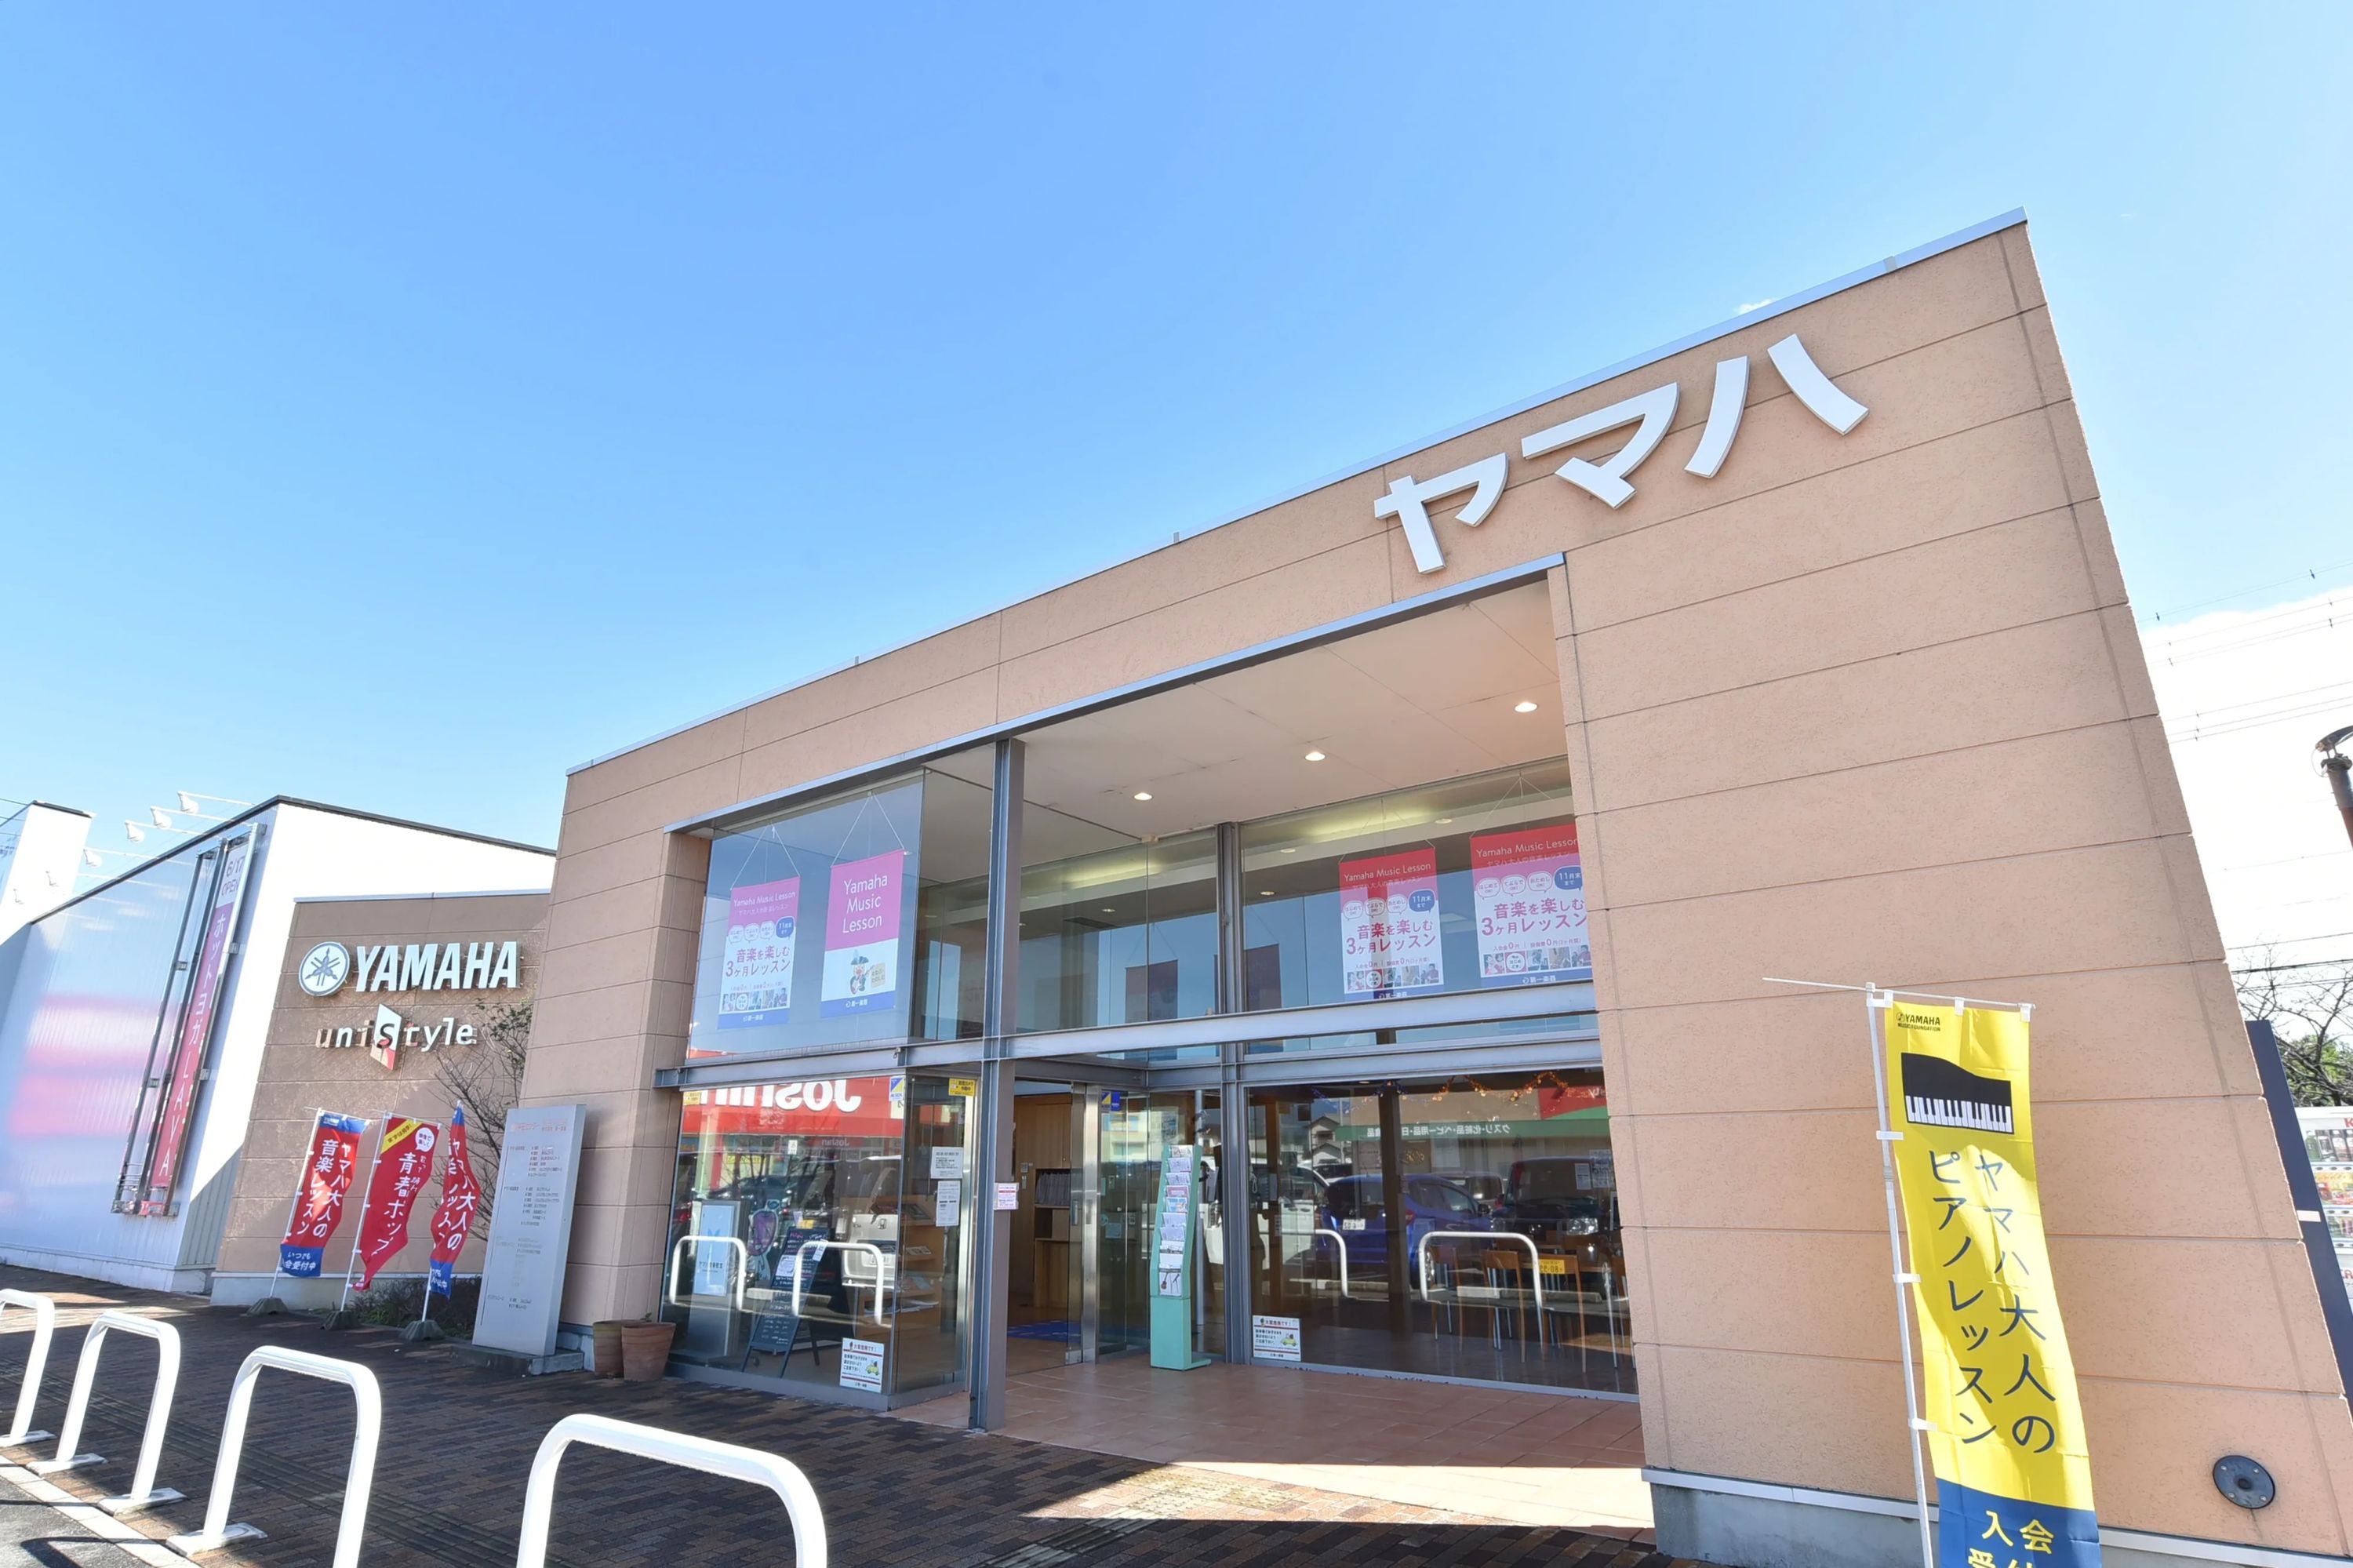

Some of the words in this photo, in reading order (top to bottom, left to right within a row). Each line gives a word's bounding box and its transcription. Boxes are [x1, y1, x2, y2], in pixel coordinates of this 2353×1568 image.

[1374, 334, 1870, 574] ヤマハ
[1476, 847, 1512, 858] Yamaha
[1344, 871, 1374, 882] Yamaha
[1377, 868, 1401, 877] Music
[1402, 863, 1431, 873] Lesson
[844, 874, 888, 895] Yamaha
[733, 896, 755, 907] Yamaha
[756, 895, 773, 905] Music
[775, 891, 795, 900] Lesson
[846, 894, 881, 914] Music
[1494, 898, 1584, 919] 音楽を楽しむ
[842, 915, 882, 933] Lesson
[1358, 919, 1433, 940] 音楽を楽しむ
[736, 946, 791, 963] 音楽を楽しむ
[355, 941, 518, 992] YAMAHA
[189, 912, 226, 1046] ホットヨガ
[1905, 1013, 1940, 1025] YAMAHA
[159, 1050, 191, 1177] LAVA
[297, 1139, 339, 1235] 音楽レッスン
[312, 1142, 352, 1238] ヤマハ大人の
[282, 1259, 316, 1271] 会受付中
[1929, 1150, 1997, 1444] ピアノレッスン
[1975, 1154, 2057, 1453] ヤマハ大人の
[1981, 1510, 2055, 1555] 入会
